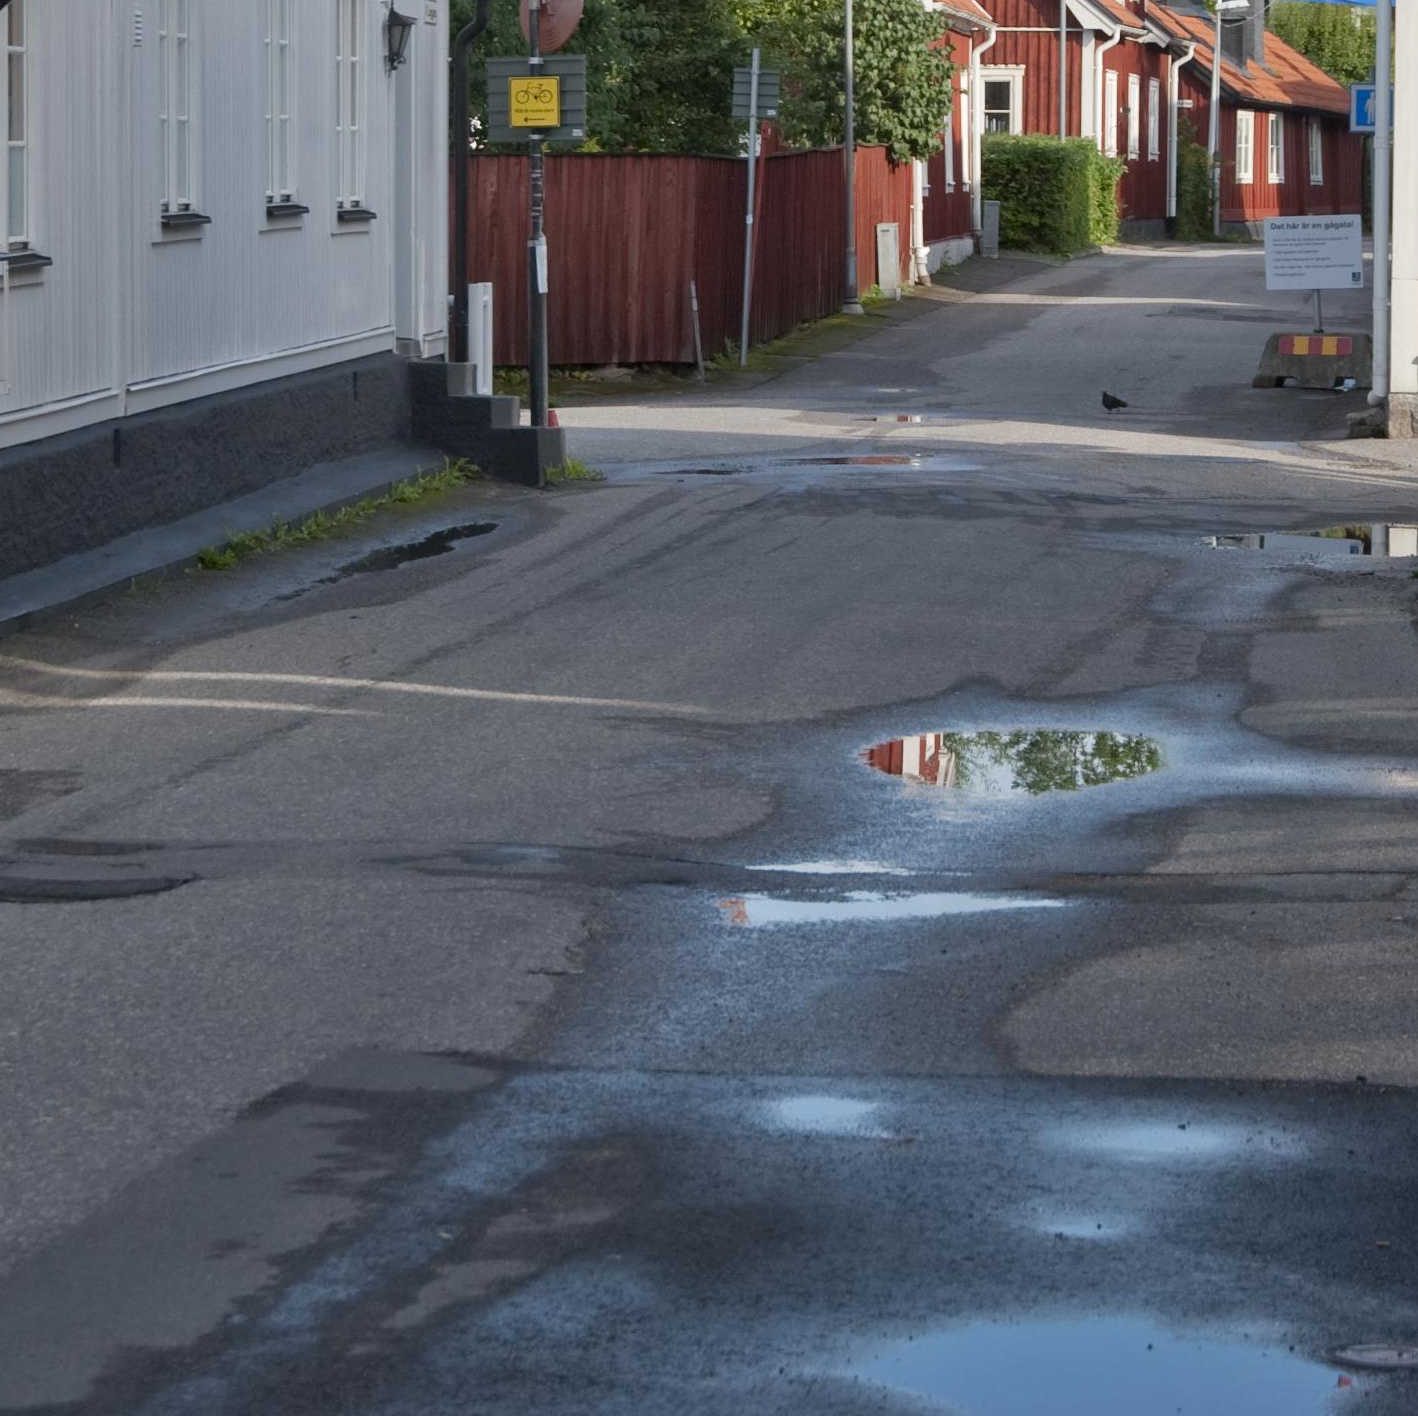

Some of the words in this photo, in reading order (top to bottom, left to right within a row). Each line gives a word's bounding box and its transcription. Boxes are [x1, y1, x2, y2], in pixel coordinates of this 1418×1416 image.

[1270, 222, 1284, 230] Det
[1286, 222, 1299, 230] här
[1302, 221, 1310, 229] är
